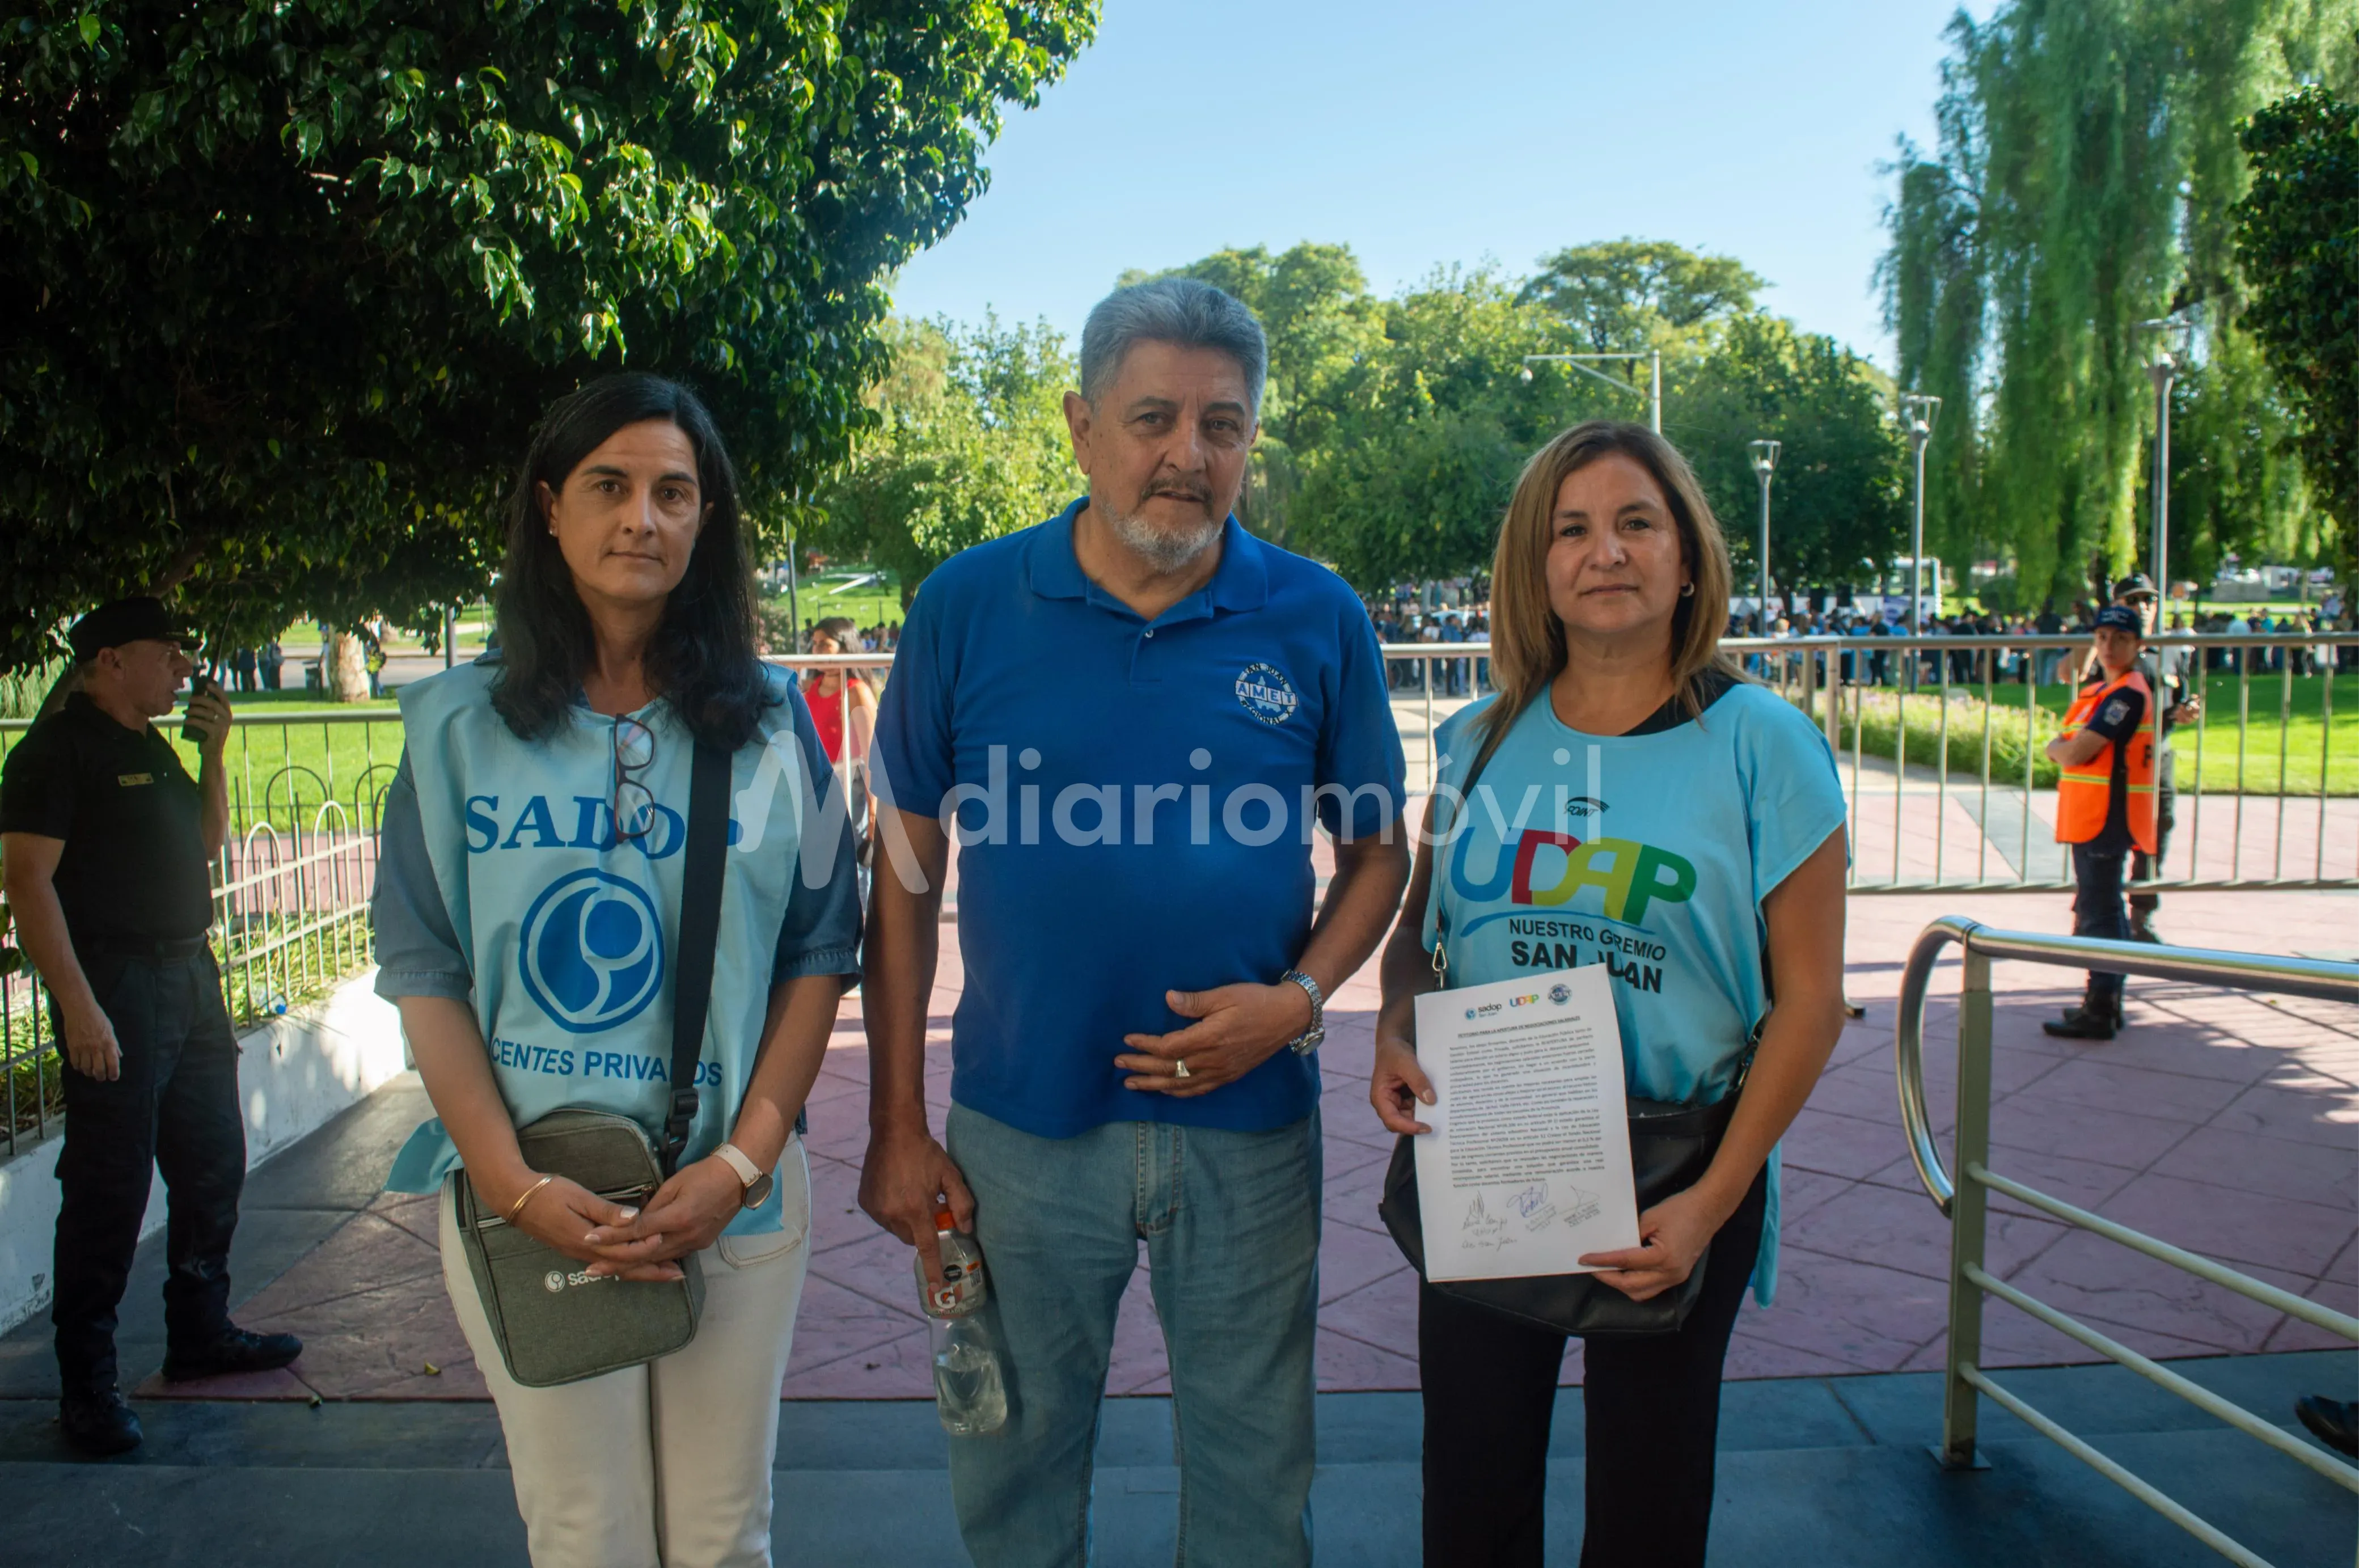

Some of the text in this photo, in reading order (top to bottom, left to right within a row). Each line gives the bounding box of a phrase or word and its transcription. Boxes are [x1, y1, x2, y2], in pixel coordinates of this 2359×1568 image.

[1266, 666, 1288, 686] JUAN
[1237, 682, 1293, 704] AMET
[466, 795, 744, 860] SADO
[1450, 826, 1697, 926] UDAP
[1509, 919, 1667, 961] NUESTRO GREMIO
[1511, 940, 1578, 969] SAN
[1478, 1003, 1502, 1013] sadop
[1510, 994, 1540, 1007] UDAP
[489, 1036, 723, 1087] CENTES PRIVAOS
